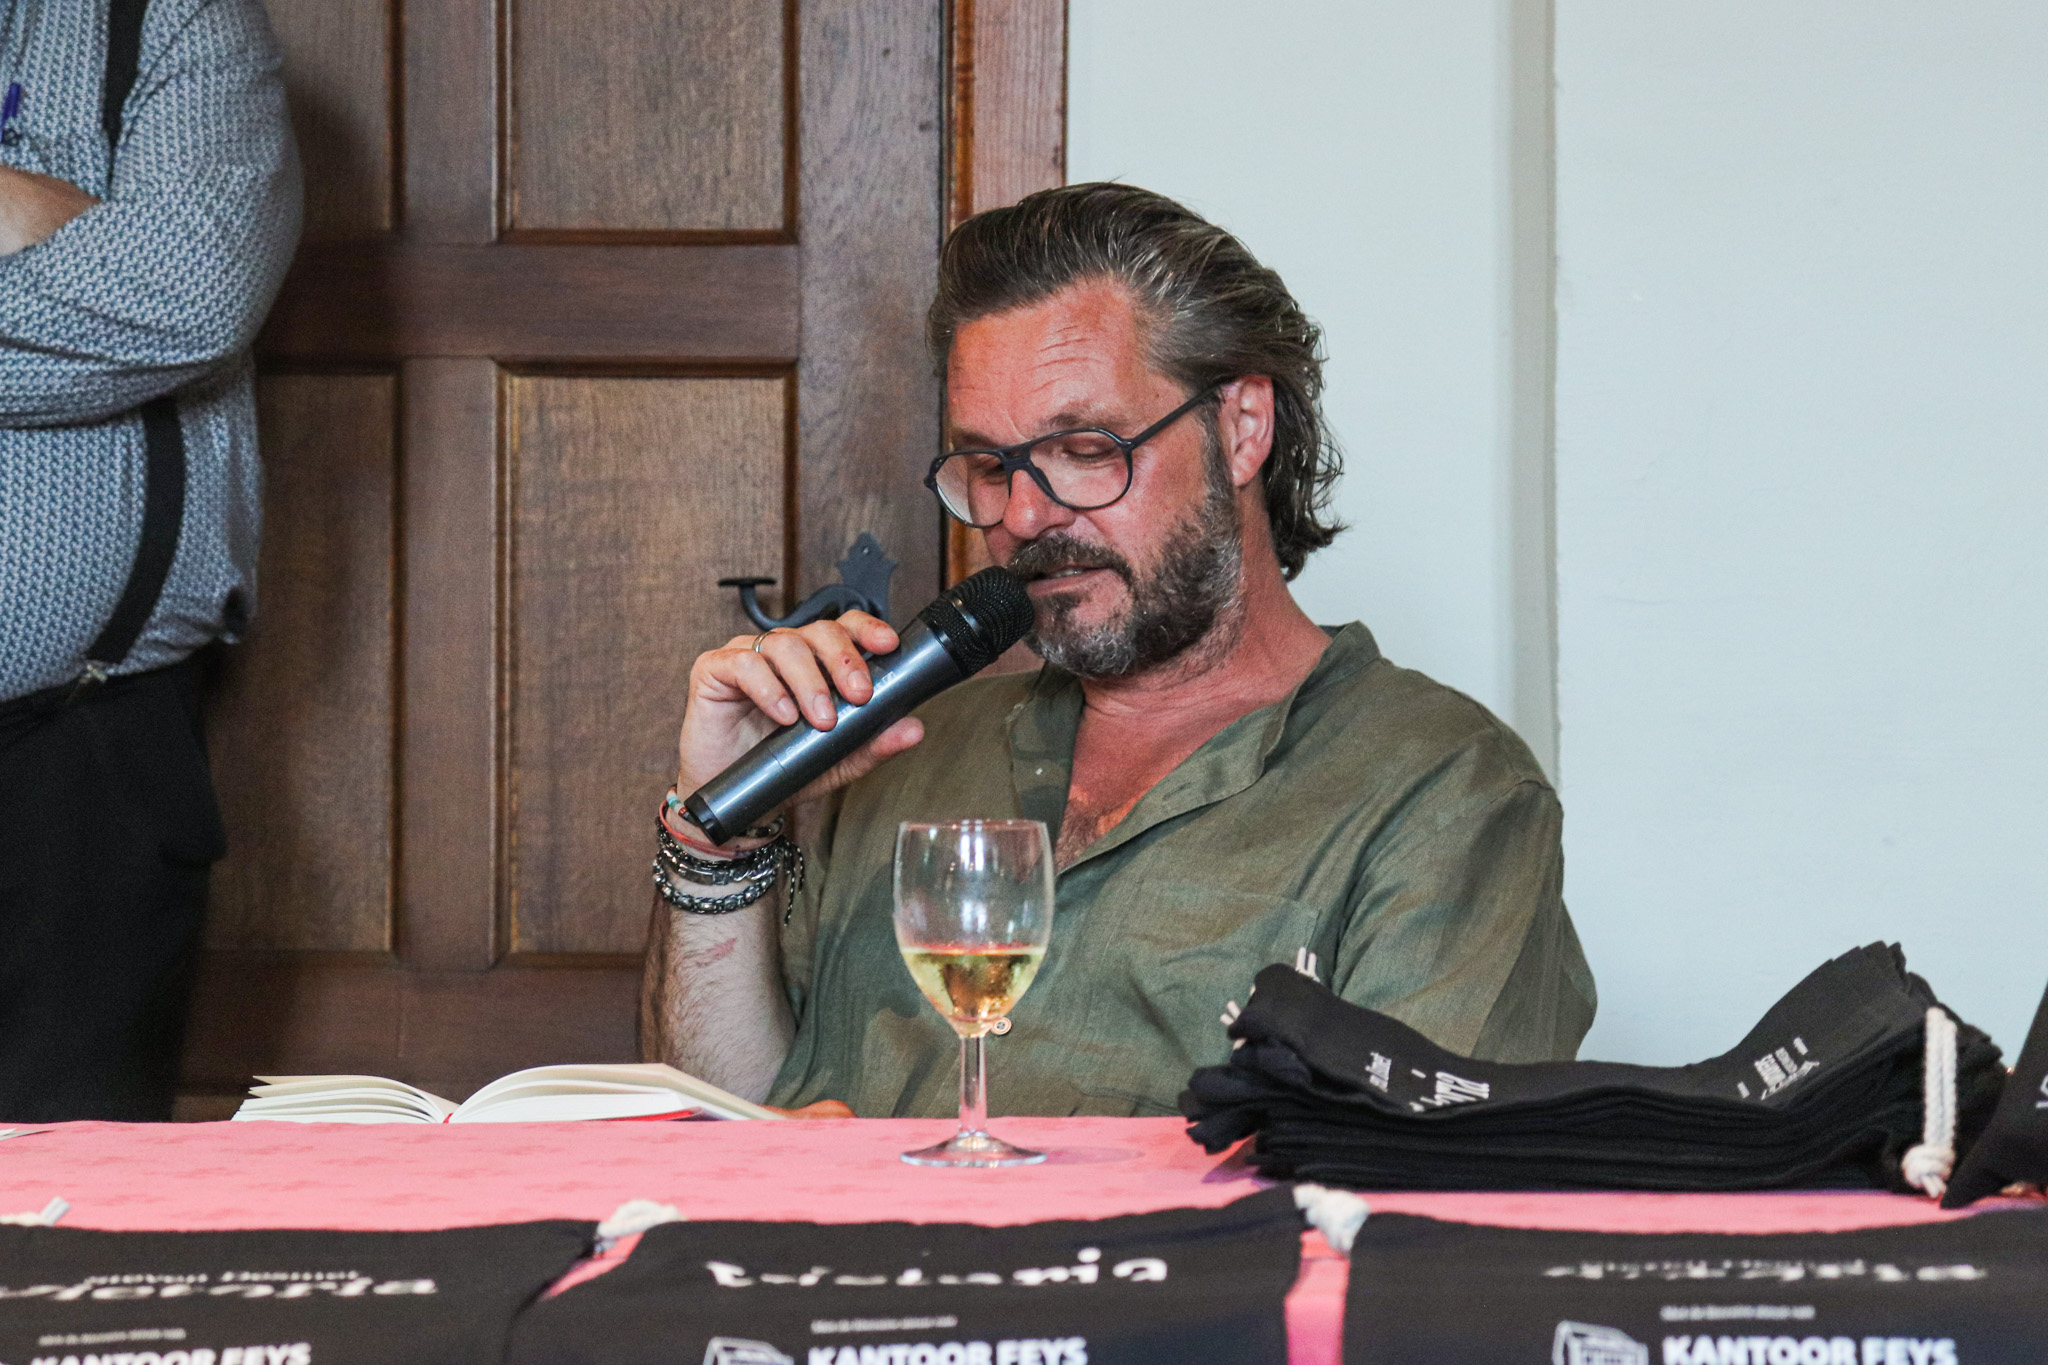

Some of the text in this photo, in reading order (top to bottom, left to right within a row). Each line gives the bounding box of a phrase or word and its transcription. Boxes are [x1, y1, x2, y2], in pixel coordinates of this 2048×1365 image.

[996, 1336, 1088, 1365] FEYS
[1662, 1335, 1857, 1365] KANTOOR
[1861, 1336, 1958, 1365] FEYS
